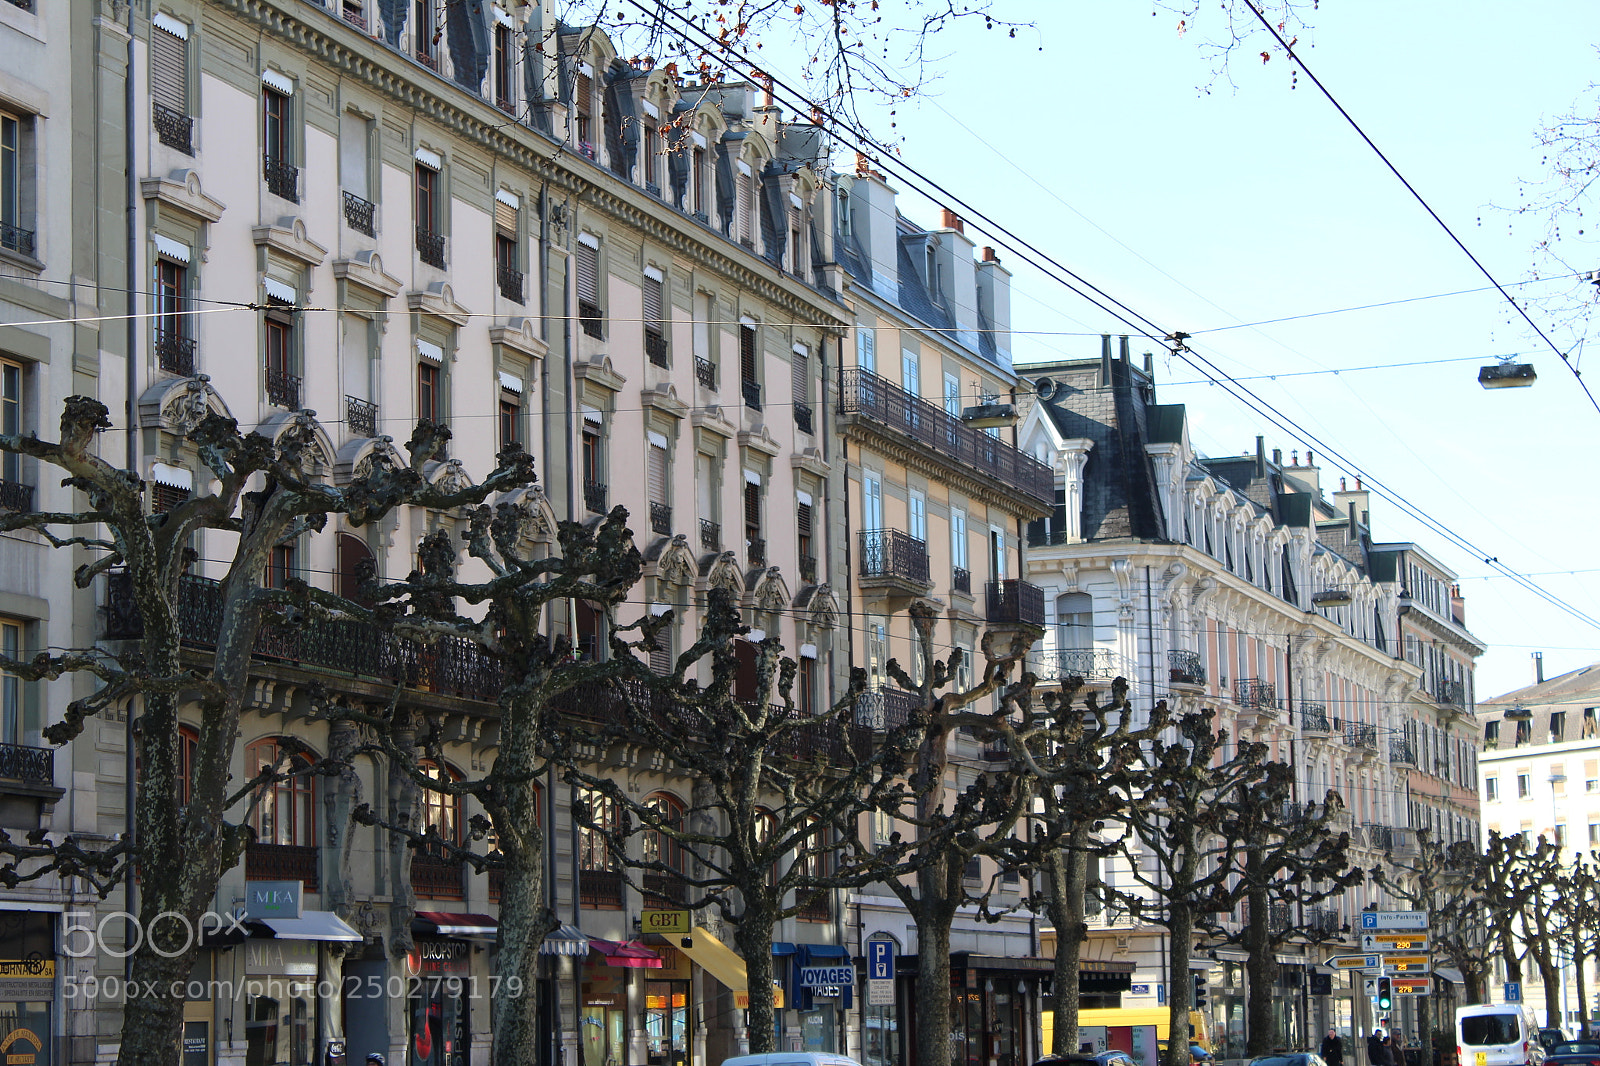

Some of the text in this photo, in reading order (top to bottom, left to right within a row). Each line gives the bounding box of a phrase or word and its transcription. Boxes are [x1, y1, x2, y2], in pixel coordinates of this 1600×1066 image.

[256, 890, 293, 904] MIKA
[649, 913, 681, 927] GBT
[422, 942, 467, 960] DROPSTOP
[1396, 941, 1411, 949] 290
[251, 943, 284, 967] MIKA
[876, 944, 886, 963] P
[45, 967, 53, 976] SA
[1397, 963, 1408, 971] 25
[800, 968, 852, 984] VOYAGES
[1398, 986, 1413, 994] 278
